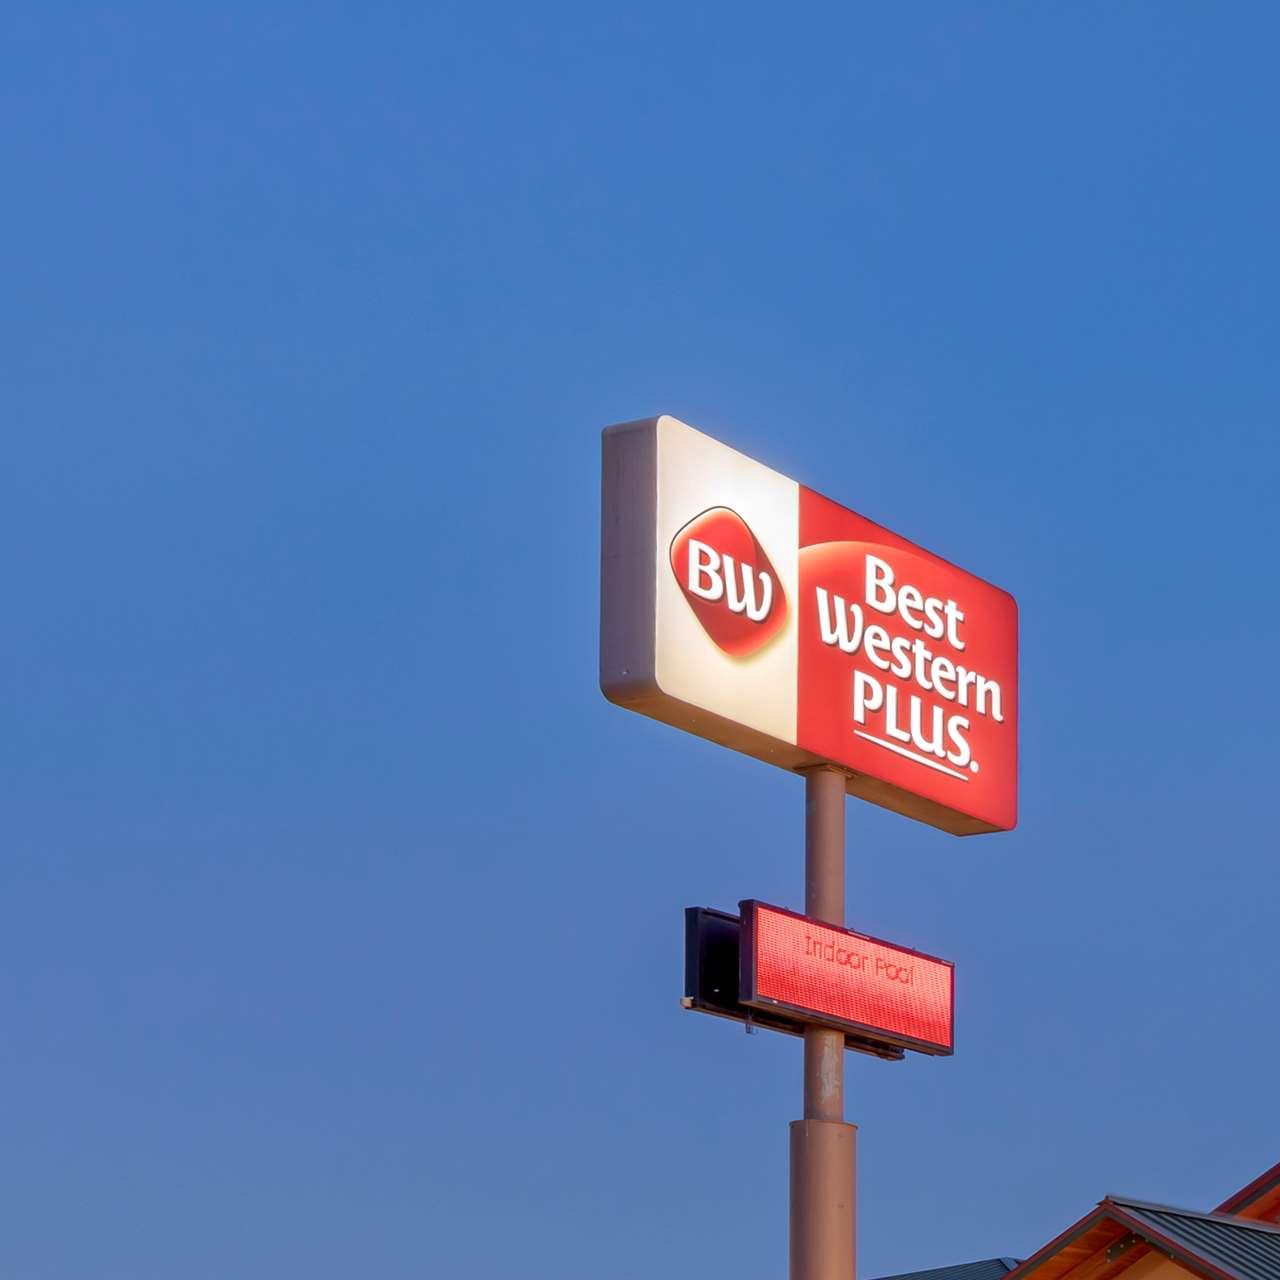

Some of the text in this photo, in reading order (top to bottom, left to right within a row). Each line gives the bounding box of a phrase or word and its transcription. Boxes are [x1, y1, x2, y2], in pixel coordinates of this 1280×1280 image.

[687, 539, 773, 622] BW
[865, 554, 966, 651] Best
[816, 586, 1004, 722] Western
[804, 935, 915, 987] Indoor Pool
